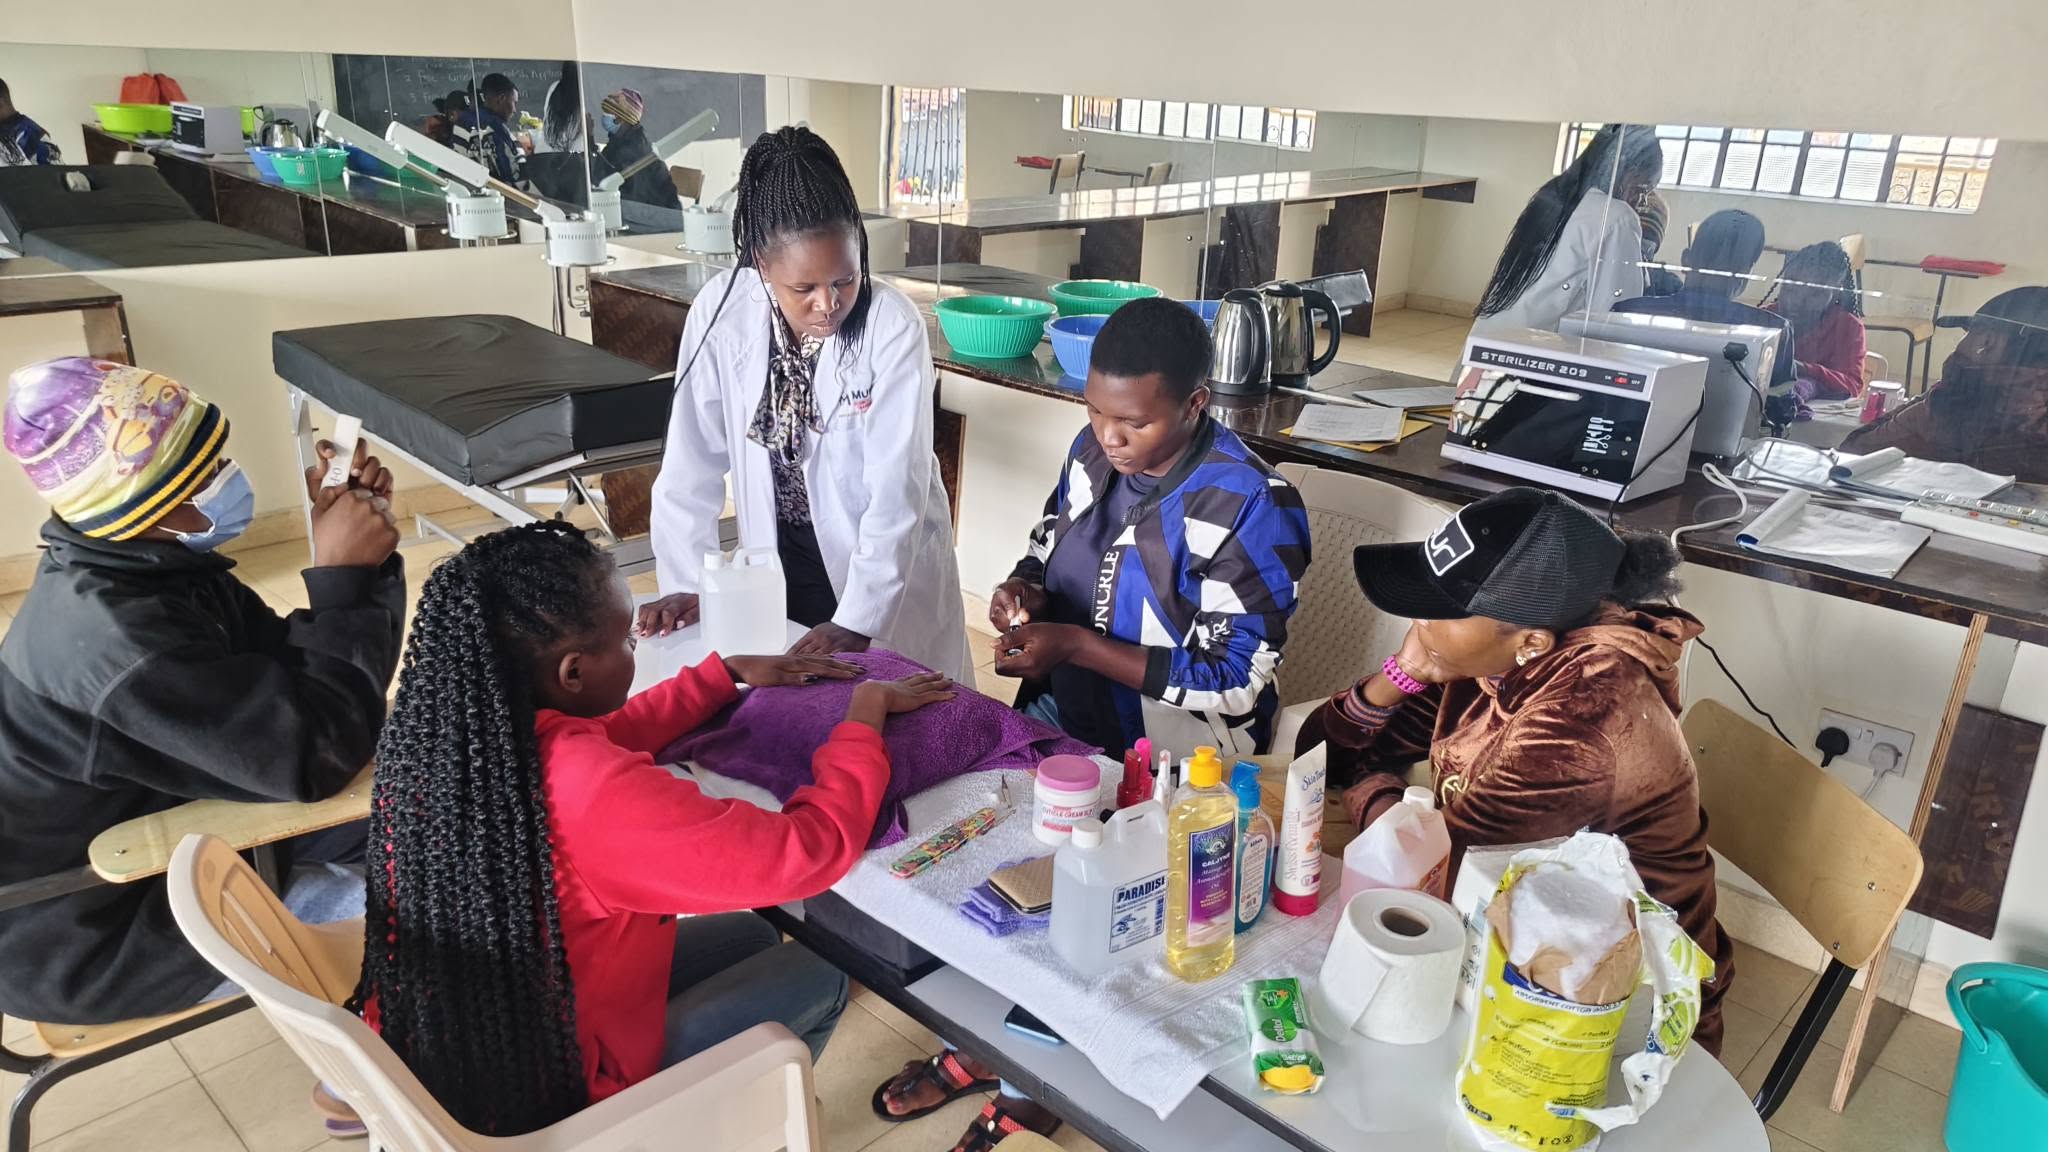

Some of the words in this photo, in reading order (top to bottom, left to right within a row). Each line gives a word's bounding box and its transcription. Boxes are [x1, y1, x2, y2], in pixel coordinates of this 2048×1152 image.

[1480, 351, 1555, 372] STERILIZER
[1558, 364, 1588, 378] 209
[1271, 1018, 1286, 1042] Dettol
